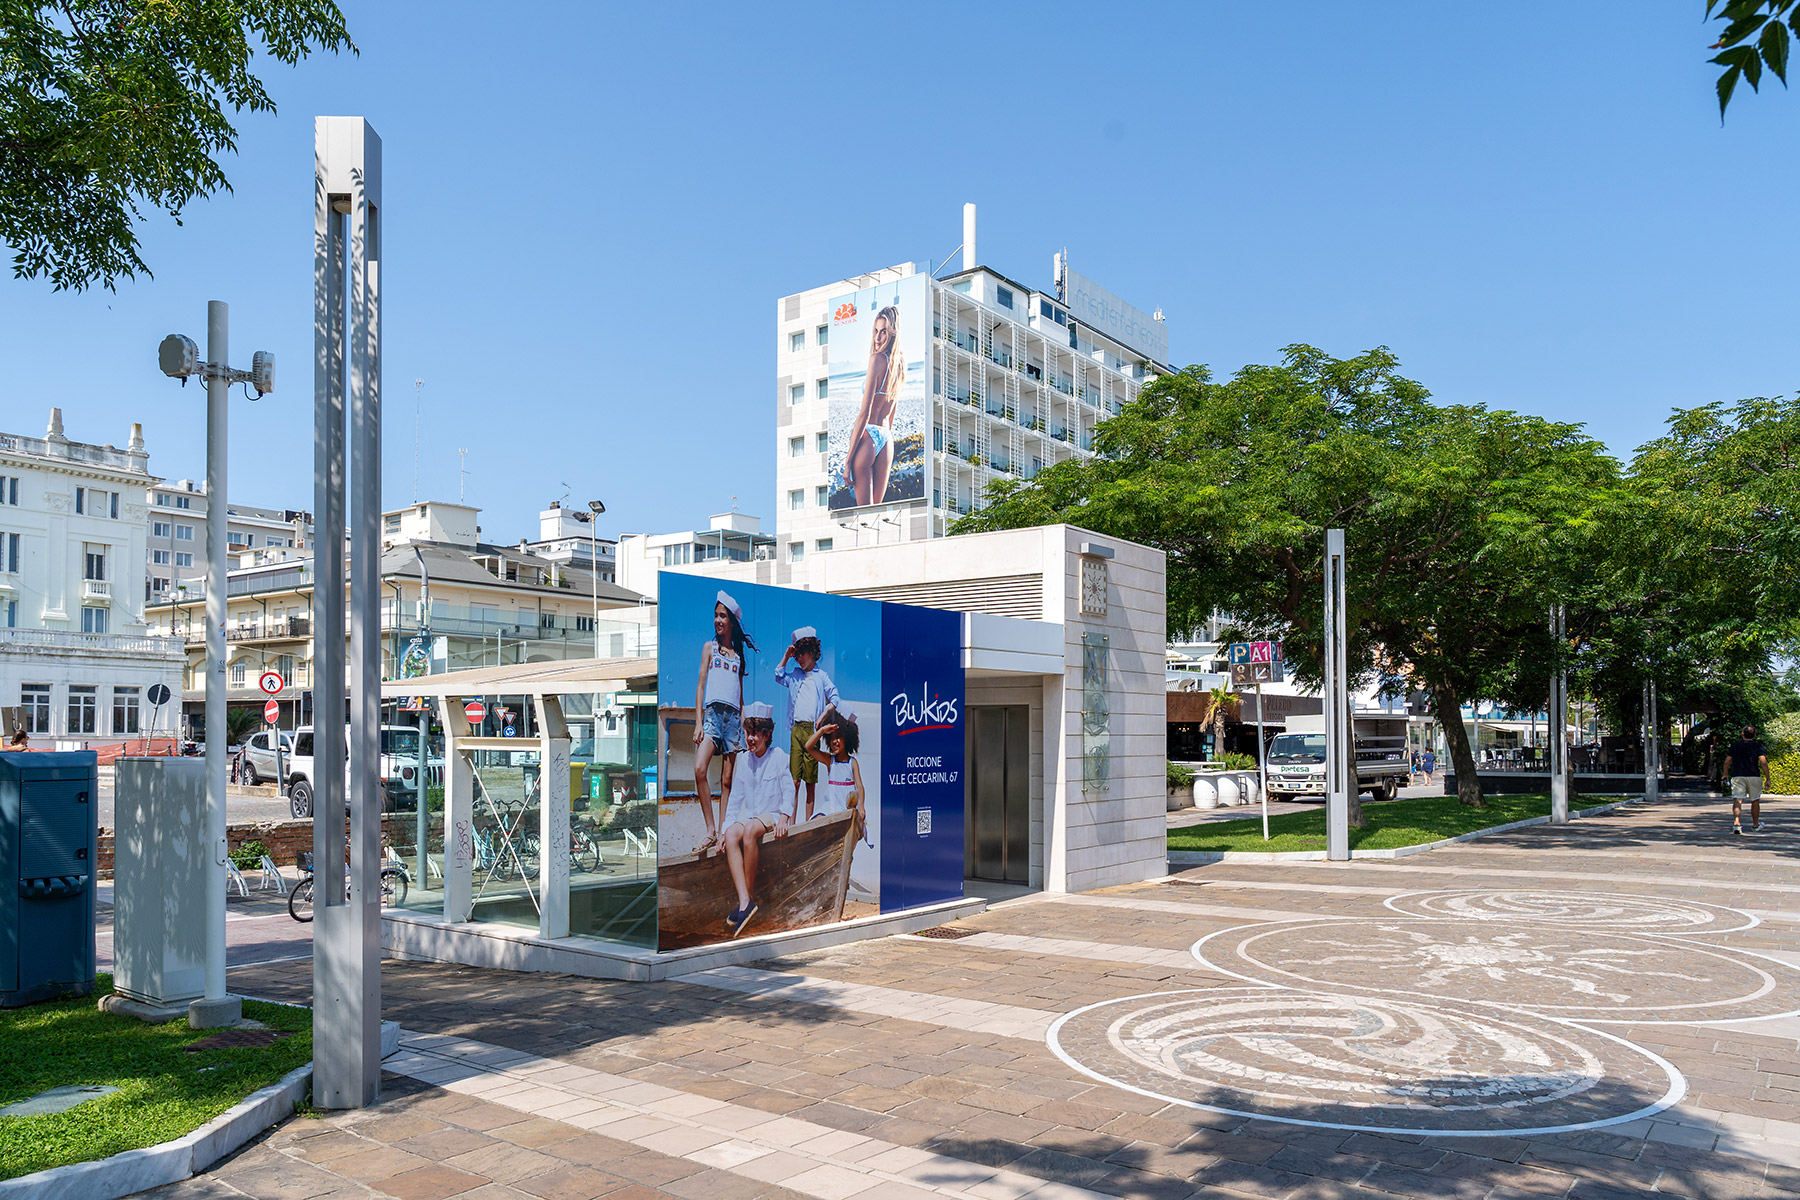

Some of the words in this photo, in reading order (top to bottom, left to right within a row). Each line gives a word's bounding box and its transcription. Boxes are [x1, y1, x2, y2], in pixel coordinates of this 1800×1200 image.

[1234, 645, 1247, 662] P
[1251, 646, 1269, 662] A1
[906, 756, 942, 768] RICCIONE
[889, 773, 906, 785] V.LE
[949, 771, 958, 782] 67
